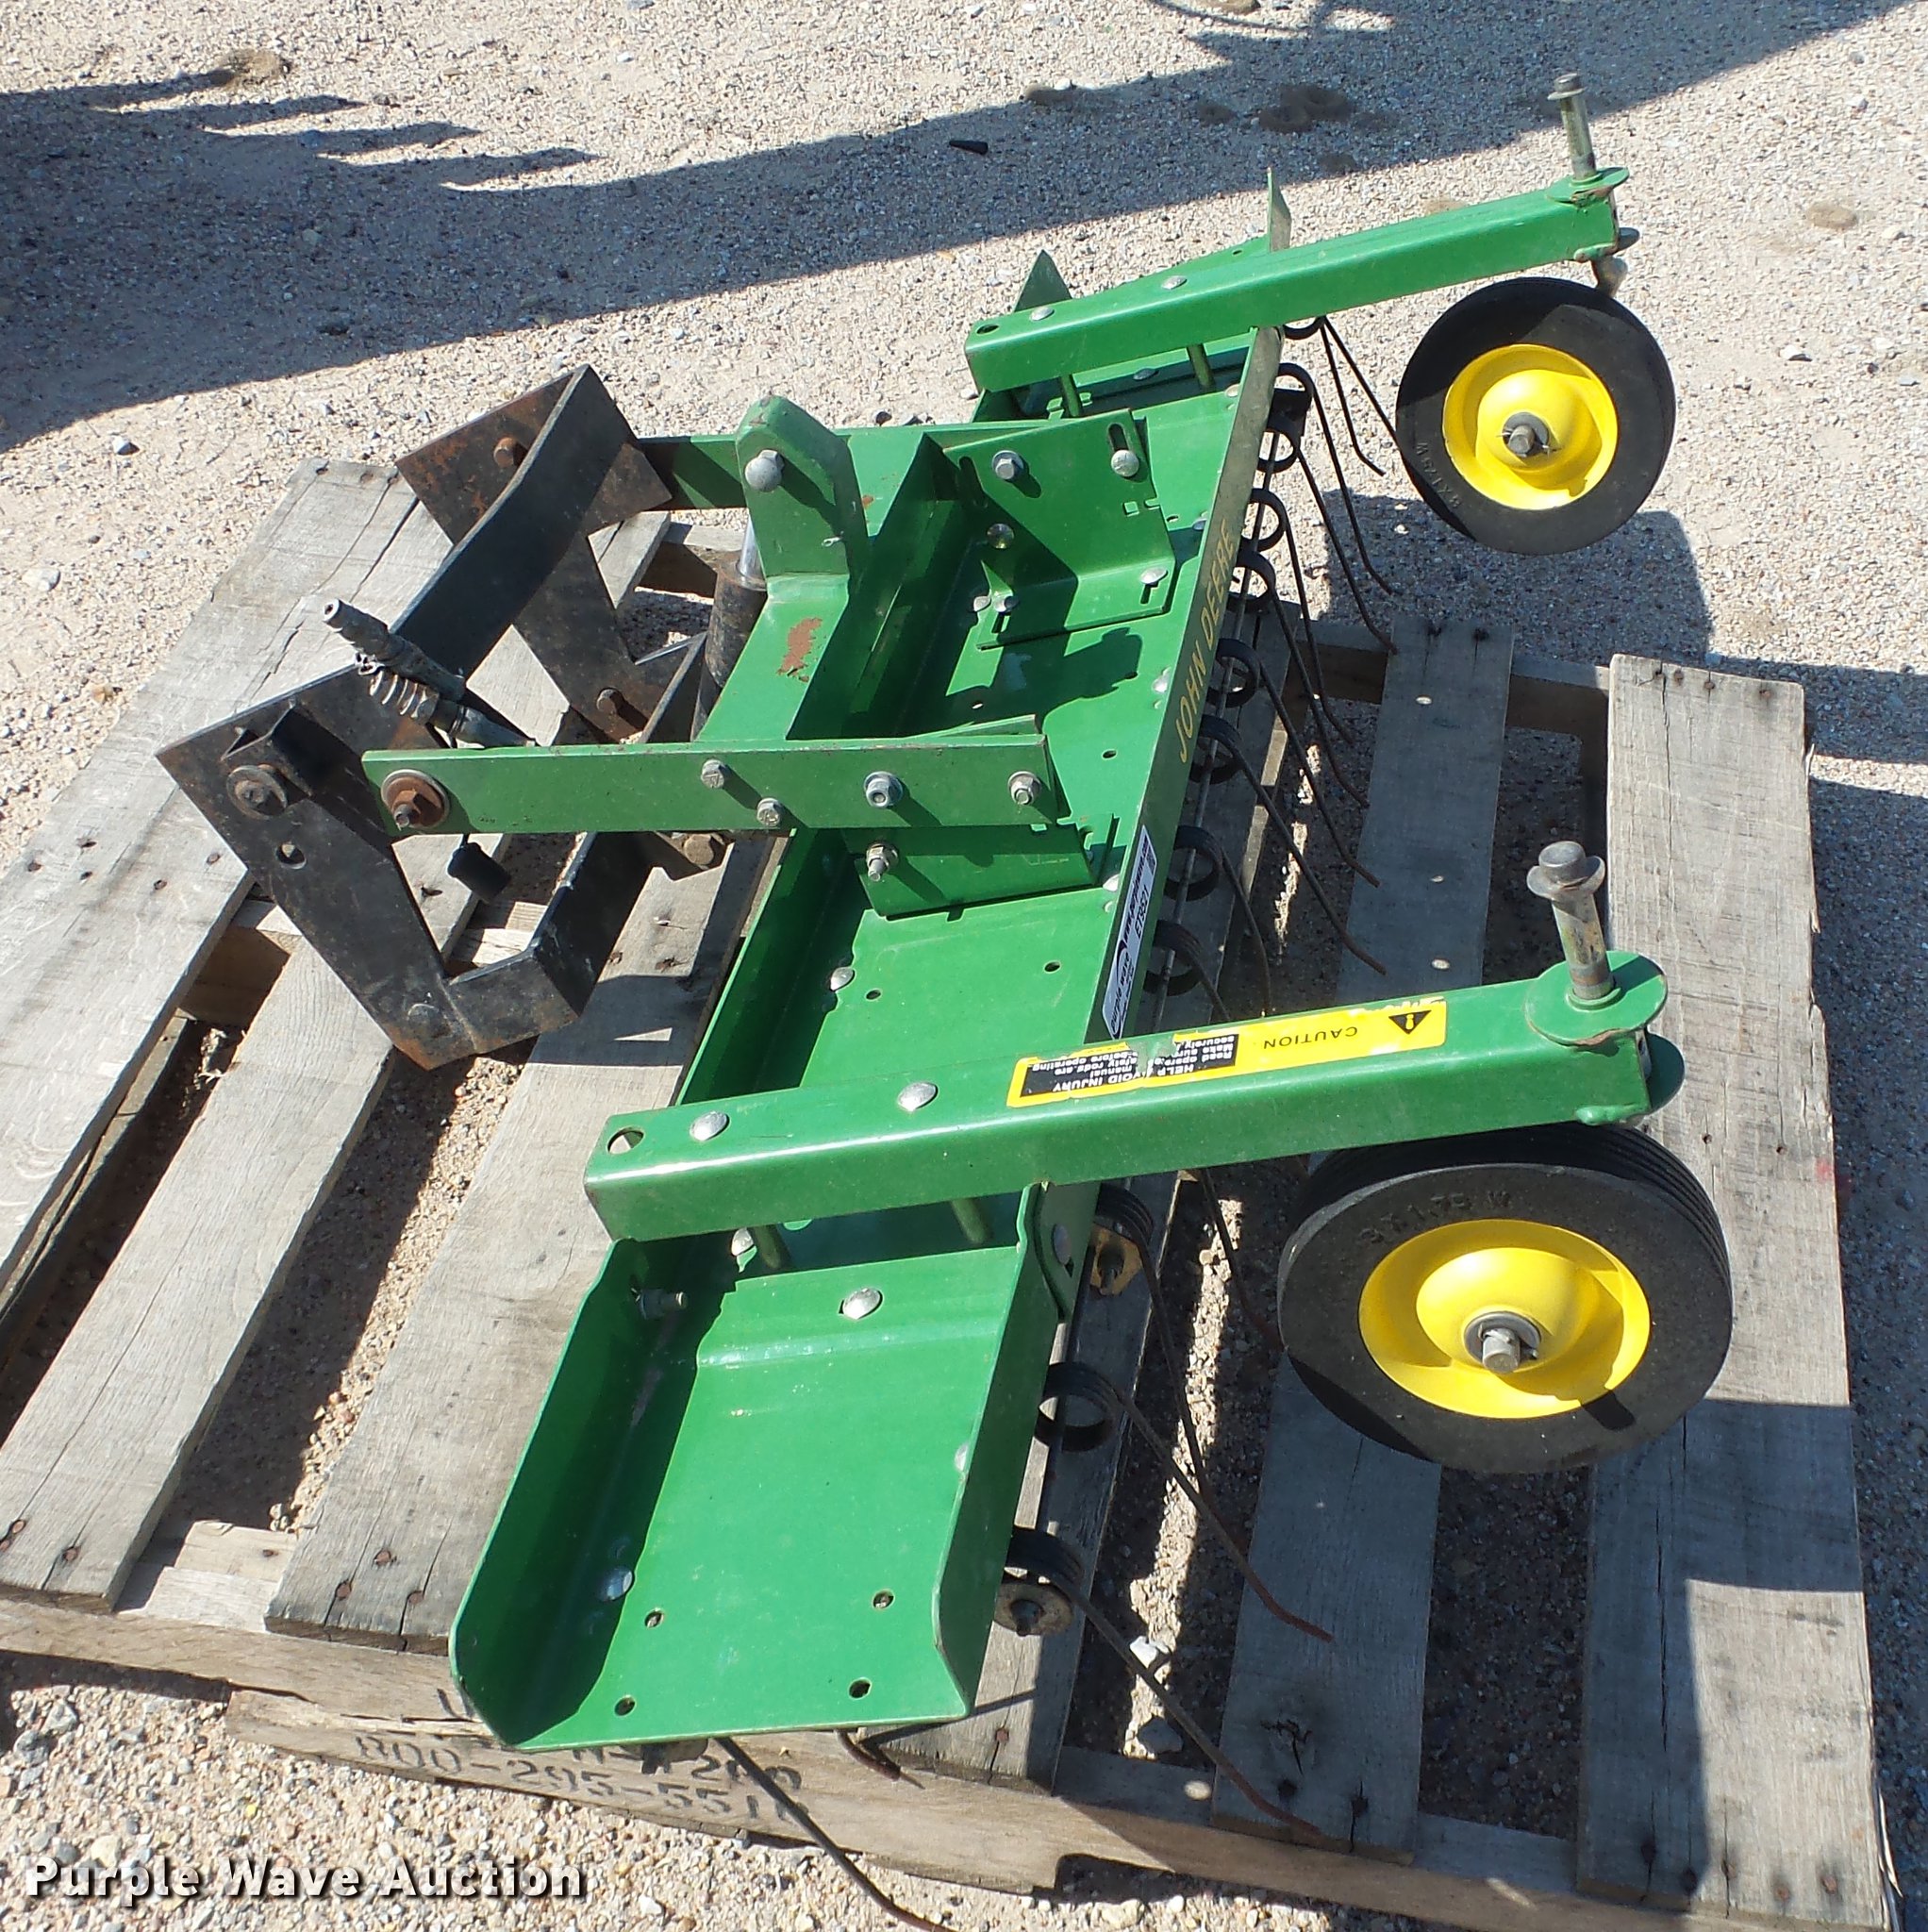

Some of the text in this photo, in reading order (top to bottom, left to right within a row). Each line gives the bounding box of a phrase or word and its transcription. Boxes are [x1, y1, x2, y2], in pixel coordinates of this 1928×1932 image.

[1175, 517, 1235, 764] JOHN DEERE
[1185, 1036, 1235, 1049] securely
[1263, 1026, 1358, 1050] CAUTION
[1202, 1042, 1234, 1055] Make
[1201, 1051, 1233, 1063] Read
[1089, 1065, 1133, 1079] manual
[1157, 1064, 1194, 1077] HELP
[1053, 1076, 1104, 1092] INJURY
